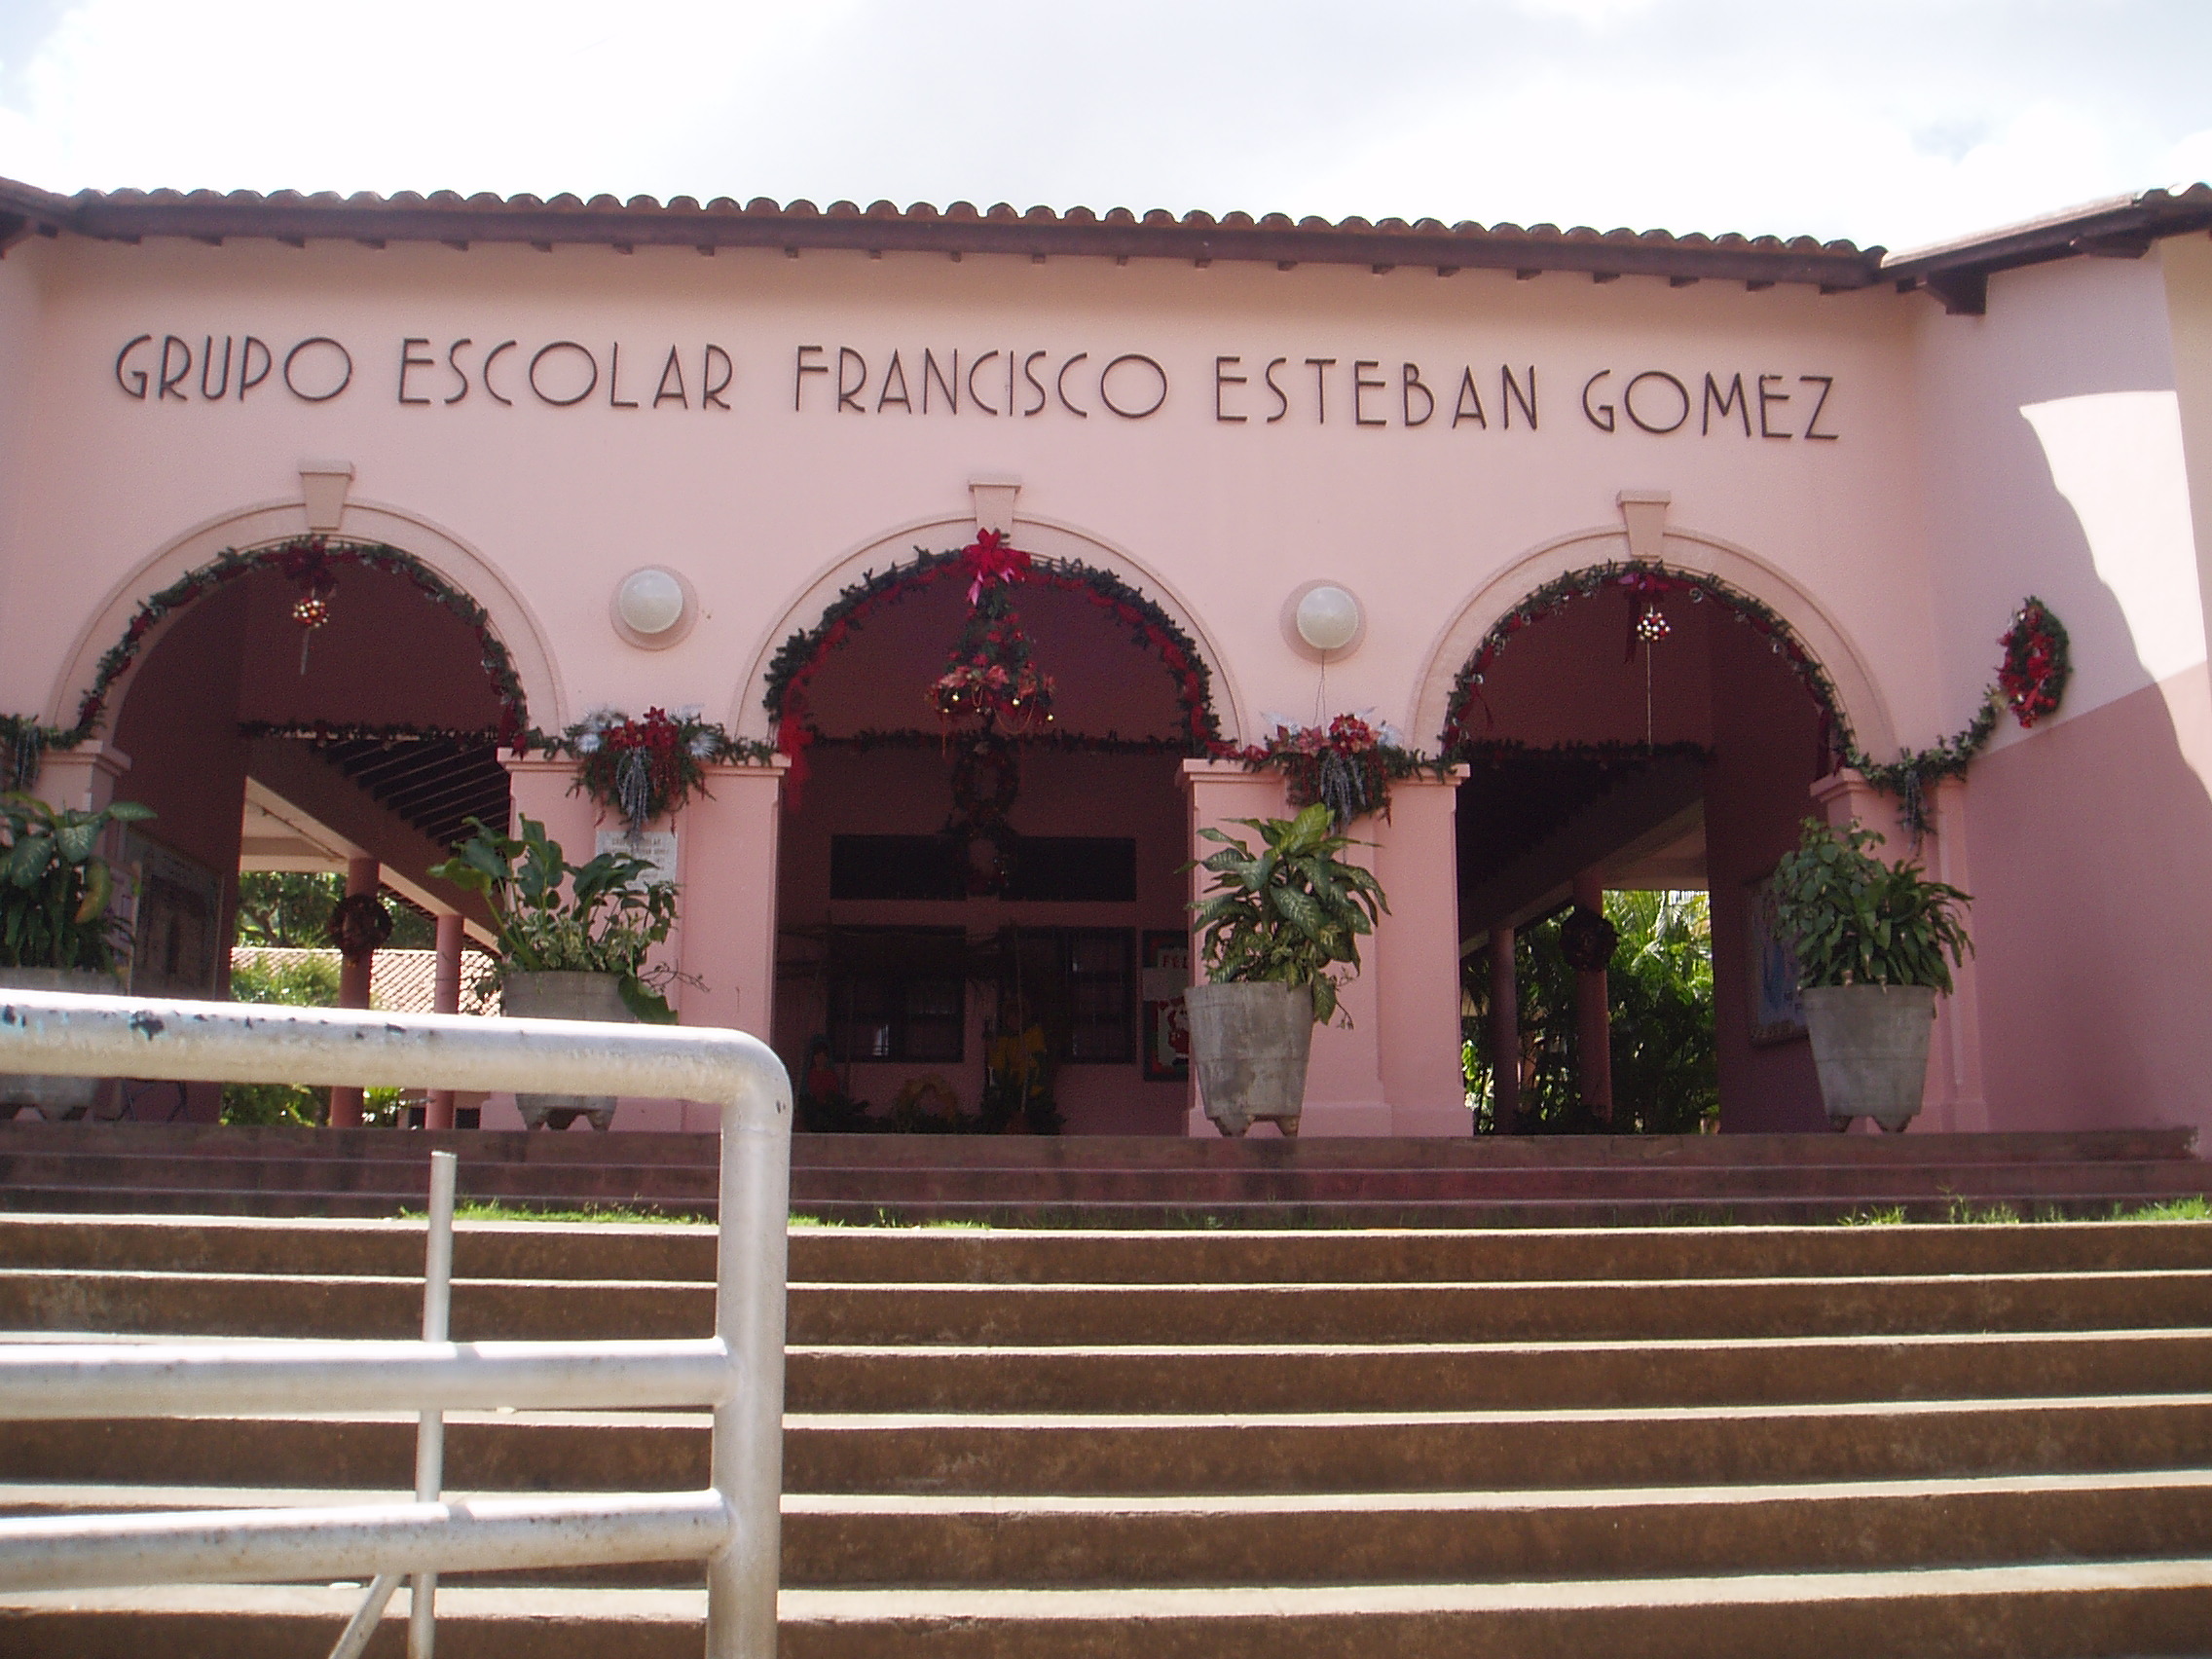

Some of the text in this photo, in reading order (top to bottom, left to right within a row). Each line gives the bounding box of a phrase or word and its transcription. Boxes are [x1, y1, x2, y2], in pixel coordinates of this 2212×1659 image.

[115, 334, 1839, 441] GRUPO ESCOLAR FRANCISCO ESTEBAN GOMEZ
